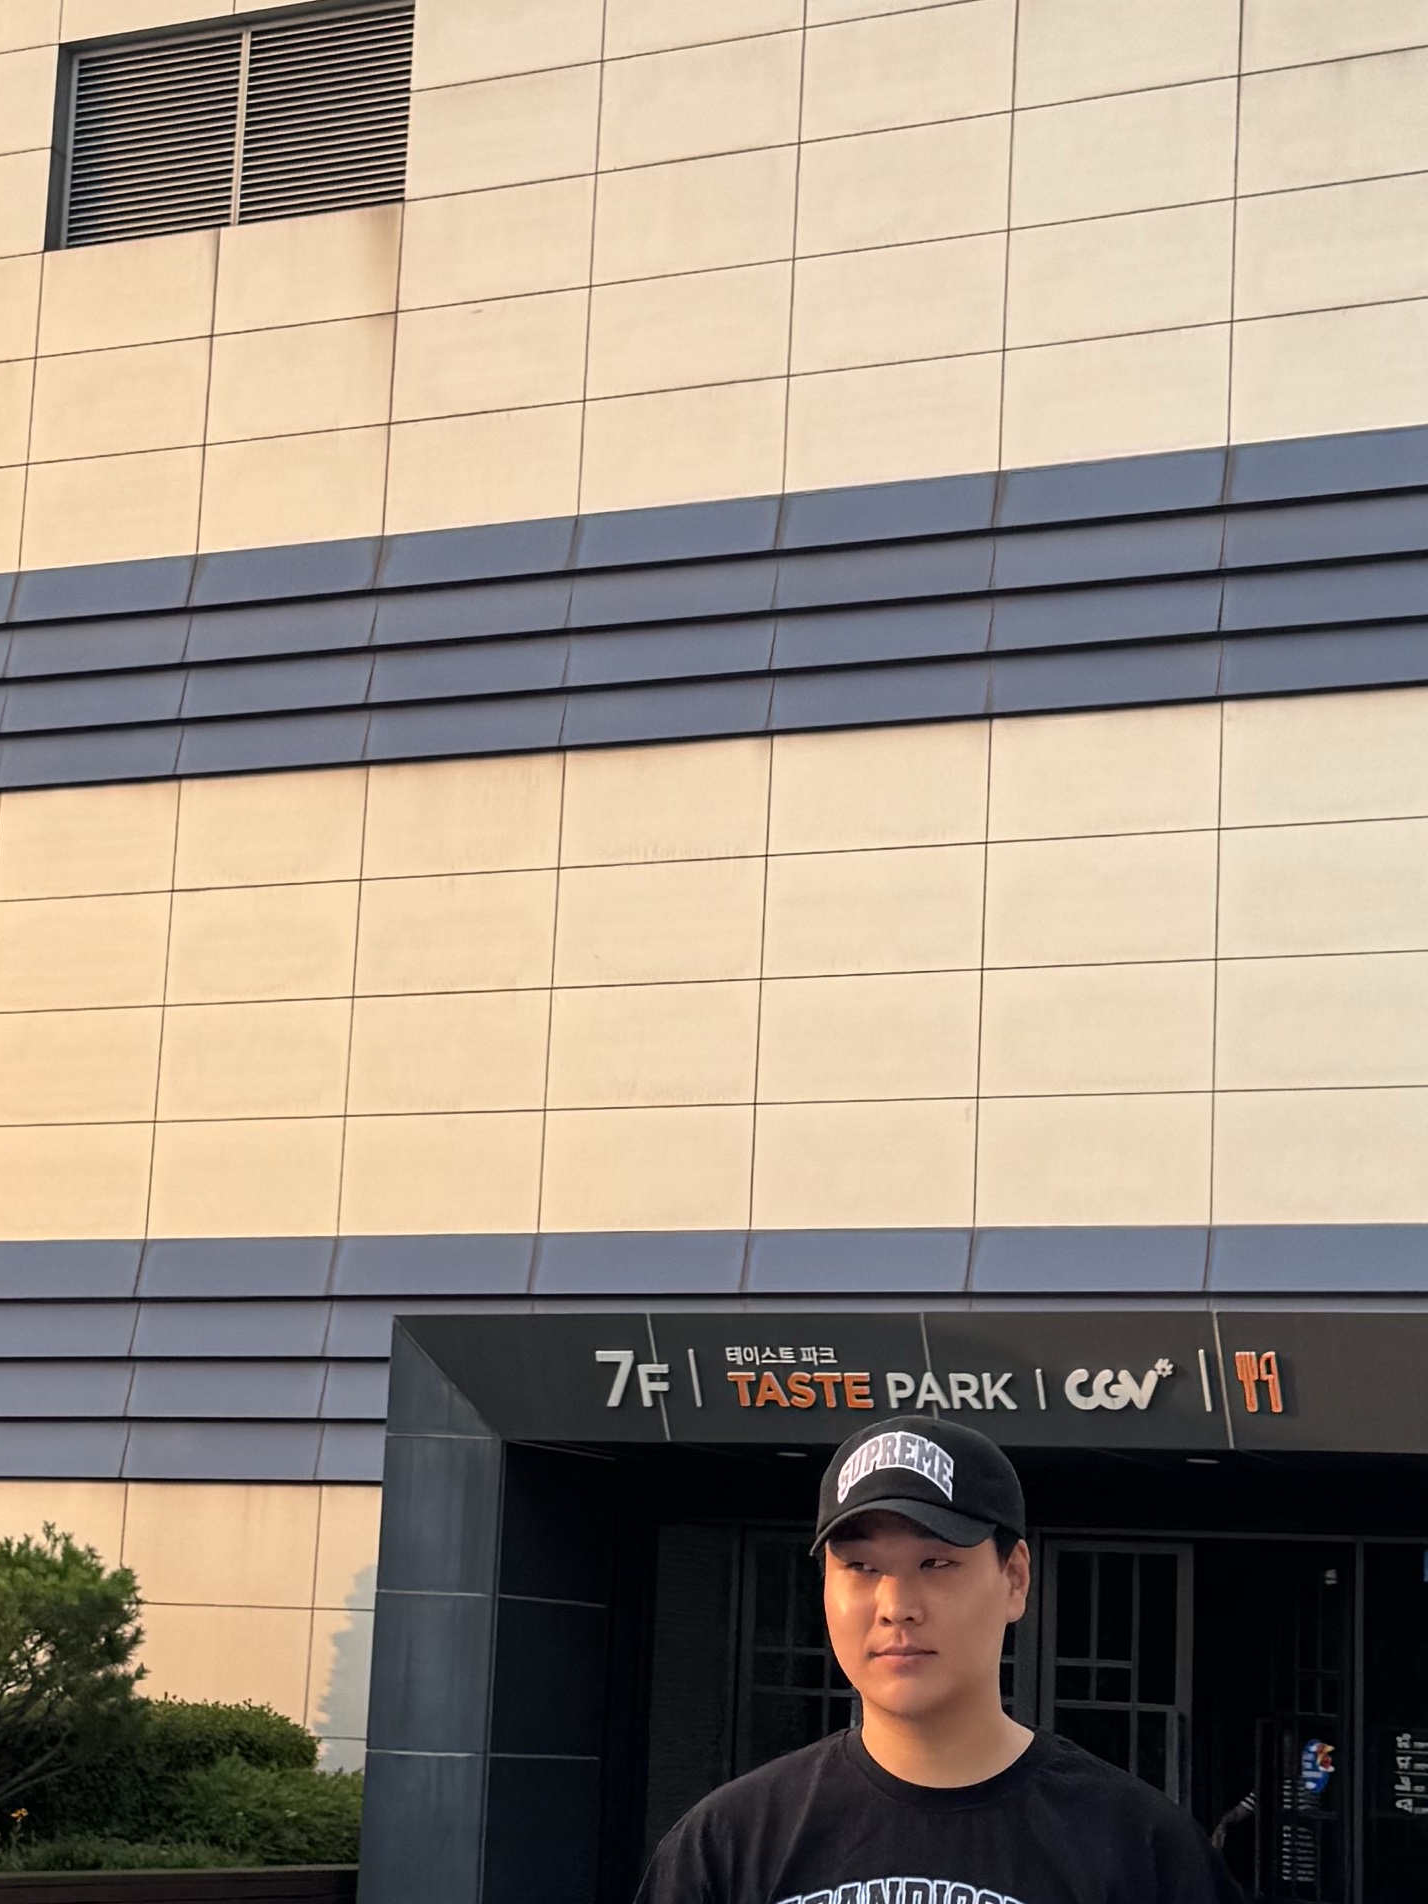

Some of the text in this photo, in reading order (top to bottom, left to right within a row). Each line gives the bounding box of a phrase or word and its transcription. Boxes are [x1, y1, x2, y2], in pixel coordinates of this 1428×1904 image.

[725, 1345, 838, 1367] 테이스트 파크
[594, 1349, 671, 1408] 7F
[726, 1370, 1019, 1411] TASTE PARK
[1064, 1367, 1160, 1411] CGV
[836, 1430, 955, 1505] SUPREME
